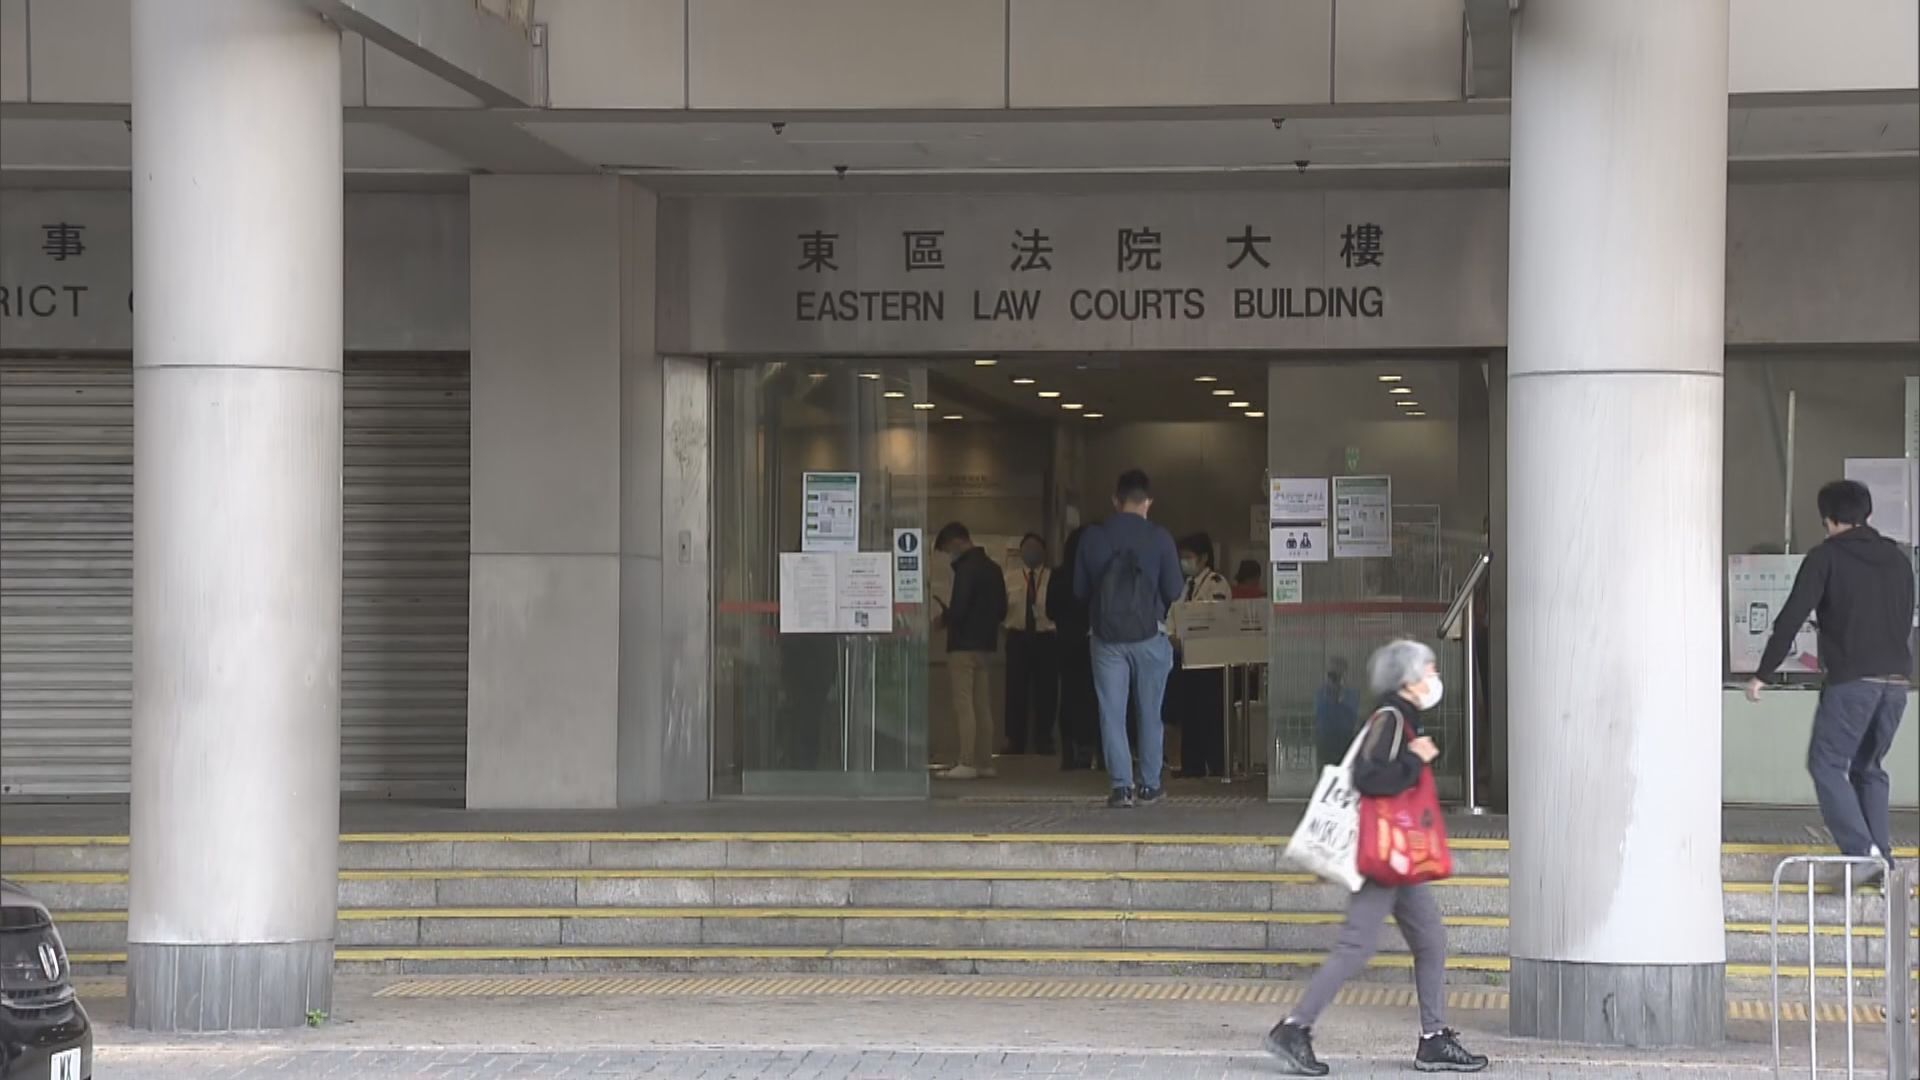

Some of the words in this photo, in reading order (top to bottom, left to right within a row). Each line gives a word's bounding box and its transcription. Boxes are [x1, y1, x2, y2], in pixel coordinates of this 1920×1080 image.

[41, 222, 87, 262] 事
[797, 222, 1385, 272] 東區法院大樓
[796, 290, 945, 323] EASTERN
[973, 289, 1041, 321] LAW
[1069, 287, 1206, 321] COURTS
[1233, 285, 1385, 320] BUILDING
